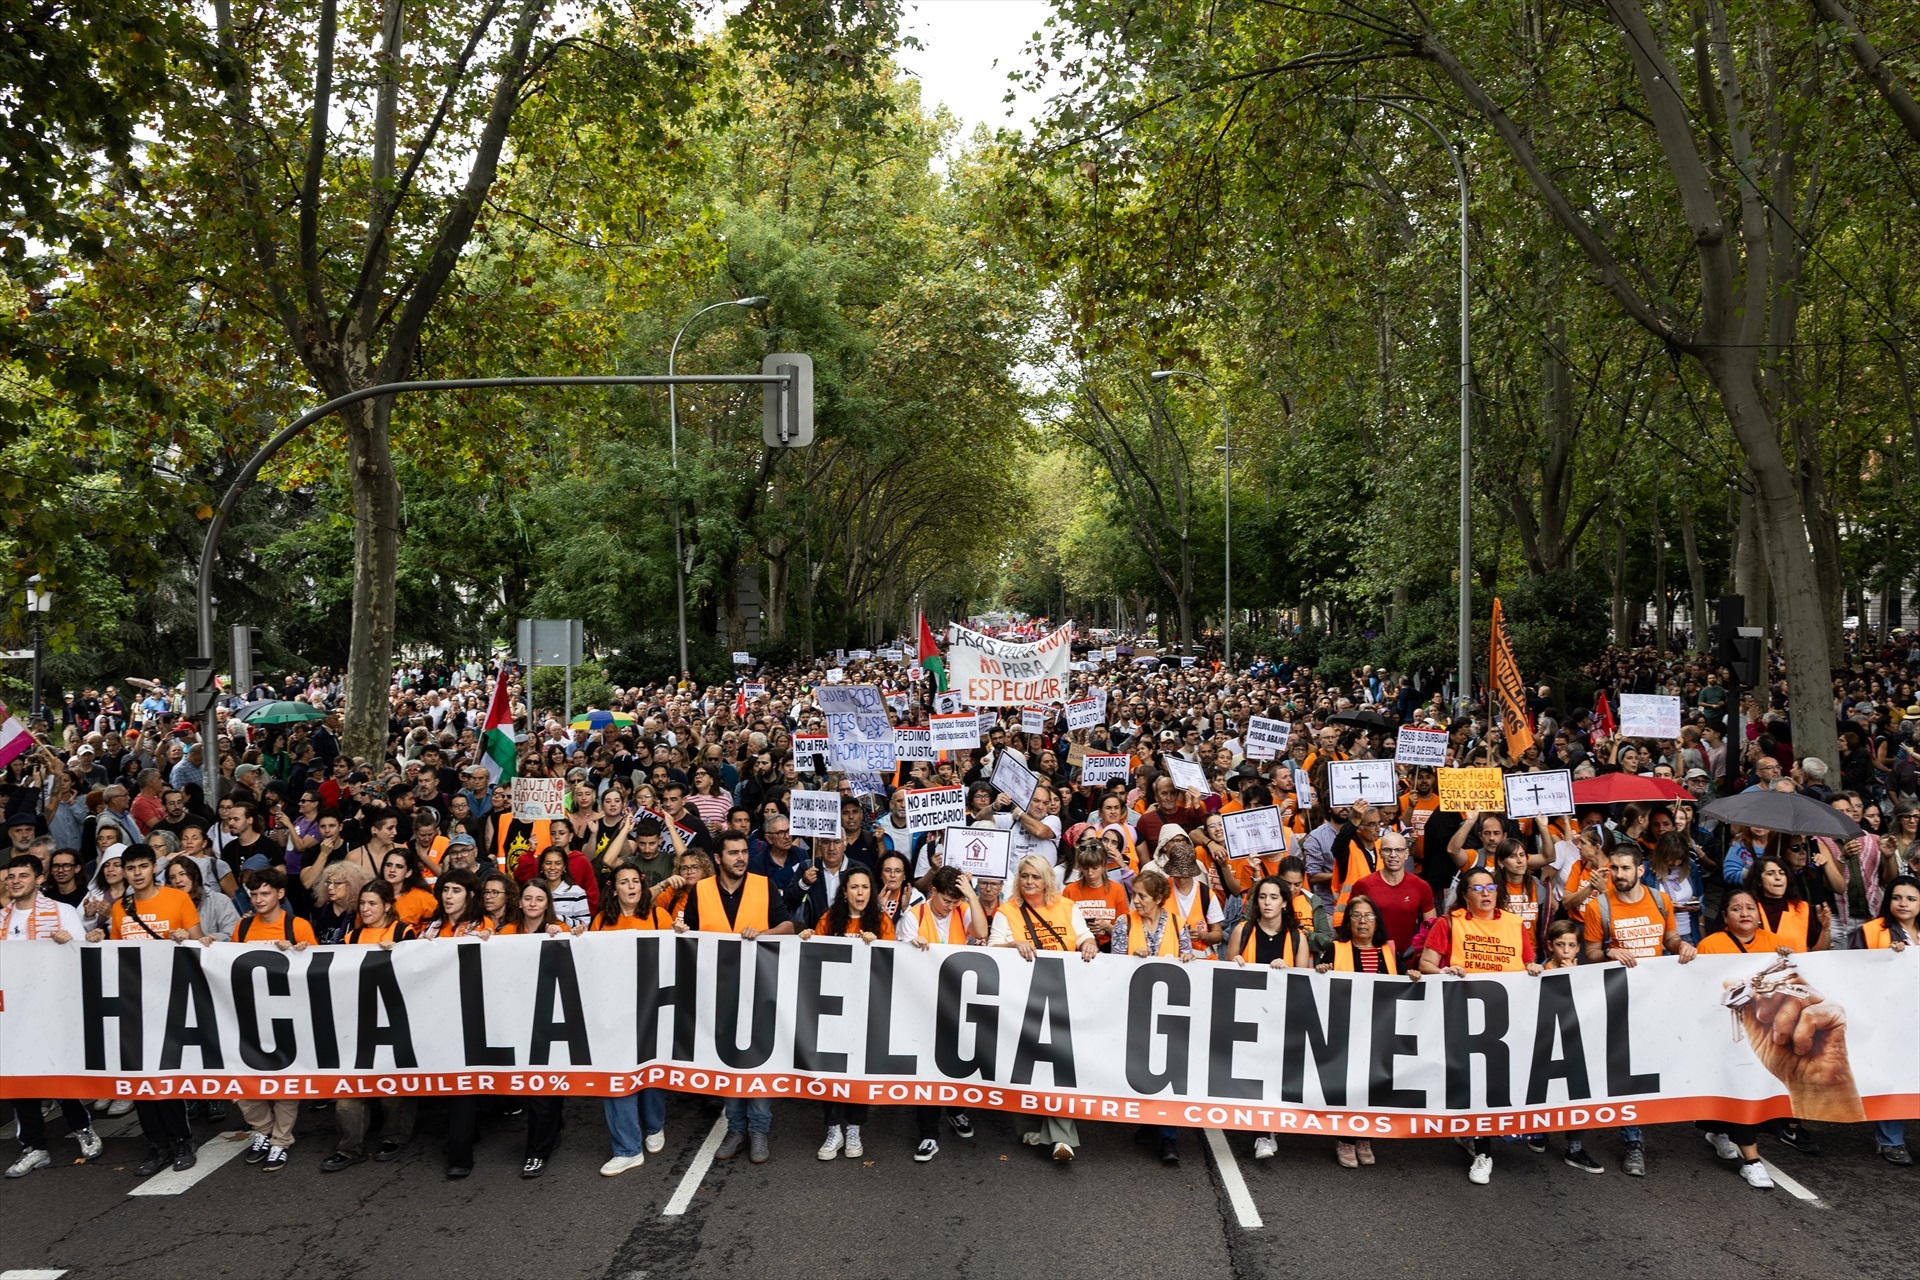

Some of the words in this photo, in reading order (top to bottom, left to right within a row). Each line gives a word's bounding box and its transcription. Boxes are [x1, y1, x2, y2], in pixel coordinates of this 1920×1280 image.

[980, 654, 1001, 675] NO
[1002, 660, 1048, 678] PARA
[968, 679, 1061, 701] ESPECULAR
[1067, 701, 1098, 716] ¡PEDIMOS
[825, 713, 856, 734] TRES
[1069, 717, 1077, 727] LO
[1078, 712, 1100, 725] JUSTO!
[894, 730, 931, 742] ¡PEDIMO
[795, 740, 806, 752] NO
[815, 740, 829, 752] FRA
[867, 757, 895, 769] SOLO
[1085, 757, 1127, 770] ¡PEDIMOS
[1083, 772, 1095, 782] LO
[515, 778, 545, 791] AQUI
[548, 778, 564, 791] NO
[1440, 781, 1465, 790] VUELVE
[1468, 781, 1474, 790] A
[514, 791, 531, 802] HAY
[531, 791, 563, 803] QUIEN
[908, 795, 919, 809] NO
[922, 794, 929, 808] al
[930, 790, 963, 806] FRAUDE
[1441, 790, 1467, 799] ESTAS
[1469, 790, 1495, 799] CASAS
[544, 802, 564, 815] VA
[1444, 800, 1461, 810] SON
[1464, 800, 1505, 811] NUESTRAS
[909, 808, 964, 829] HIPOTECARIO!
[961, 830, 995, 838] CARABANCHEL
[962, 860, 983, 868] RESISTE
[1614, 916, 1651, 929] SINDICATO
[1616, 930, 1627, 939] DE
[1627, 925, 1663, 938] INQUILINAS
[1465, 934, 1501, 944] SINDICATO
[1464, 942, 1475, 951] DE
[1475, 943, 1515, 956] INQUILINAS
[1465, 951, 1470, 960] E
[1470, 952, 1511, 963] INQUILINOS
[1464, 960, 1474, 969] DE
[1475, 961, 1503, 972] MADRID
[81, 945, 418, 1072] HACIA
[457, 939, 593, 1067] LA
[636, 936, 1078, 1089] HUELGA
[1125, 961, 1661, 1110] GENERAL
[115, 1078, 239, 1097] BAJADA
[260, 1077, 320, 1095] DEL
[338, 1074, 496, 1095] ALQUILER
[510, 1074, 571, 1092] 50%
[609, 1067, 850, 1100] EXPROPIACIÓN
[868, 1081, 1004, 1107] FONDOS
[1020, 1094, 1141, 1119] BUITRE
[1184, 1105, 1392, 1133] CONTRATOS
[1410, 1104, 1638, 1135] INDEFINIDOS
